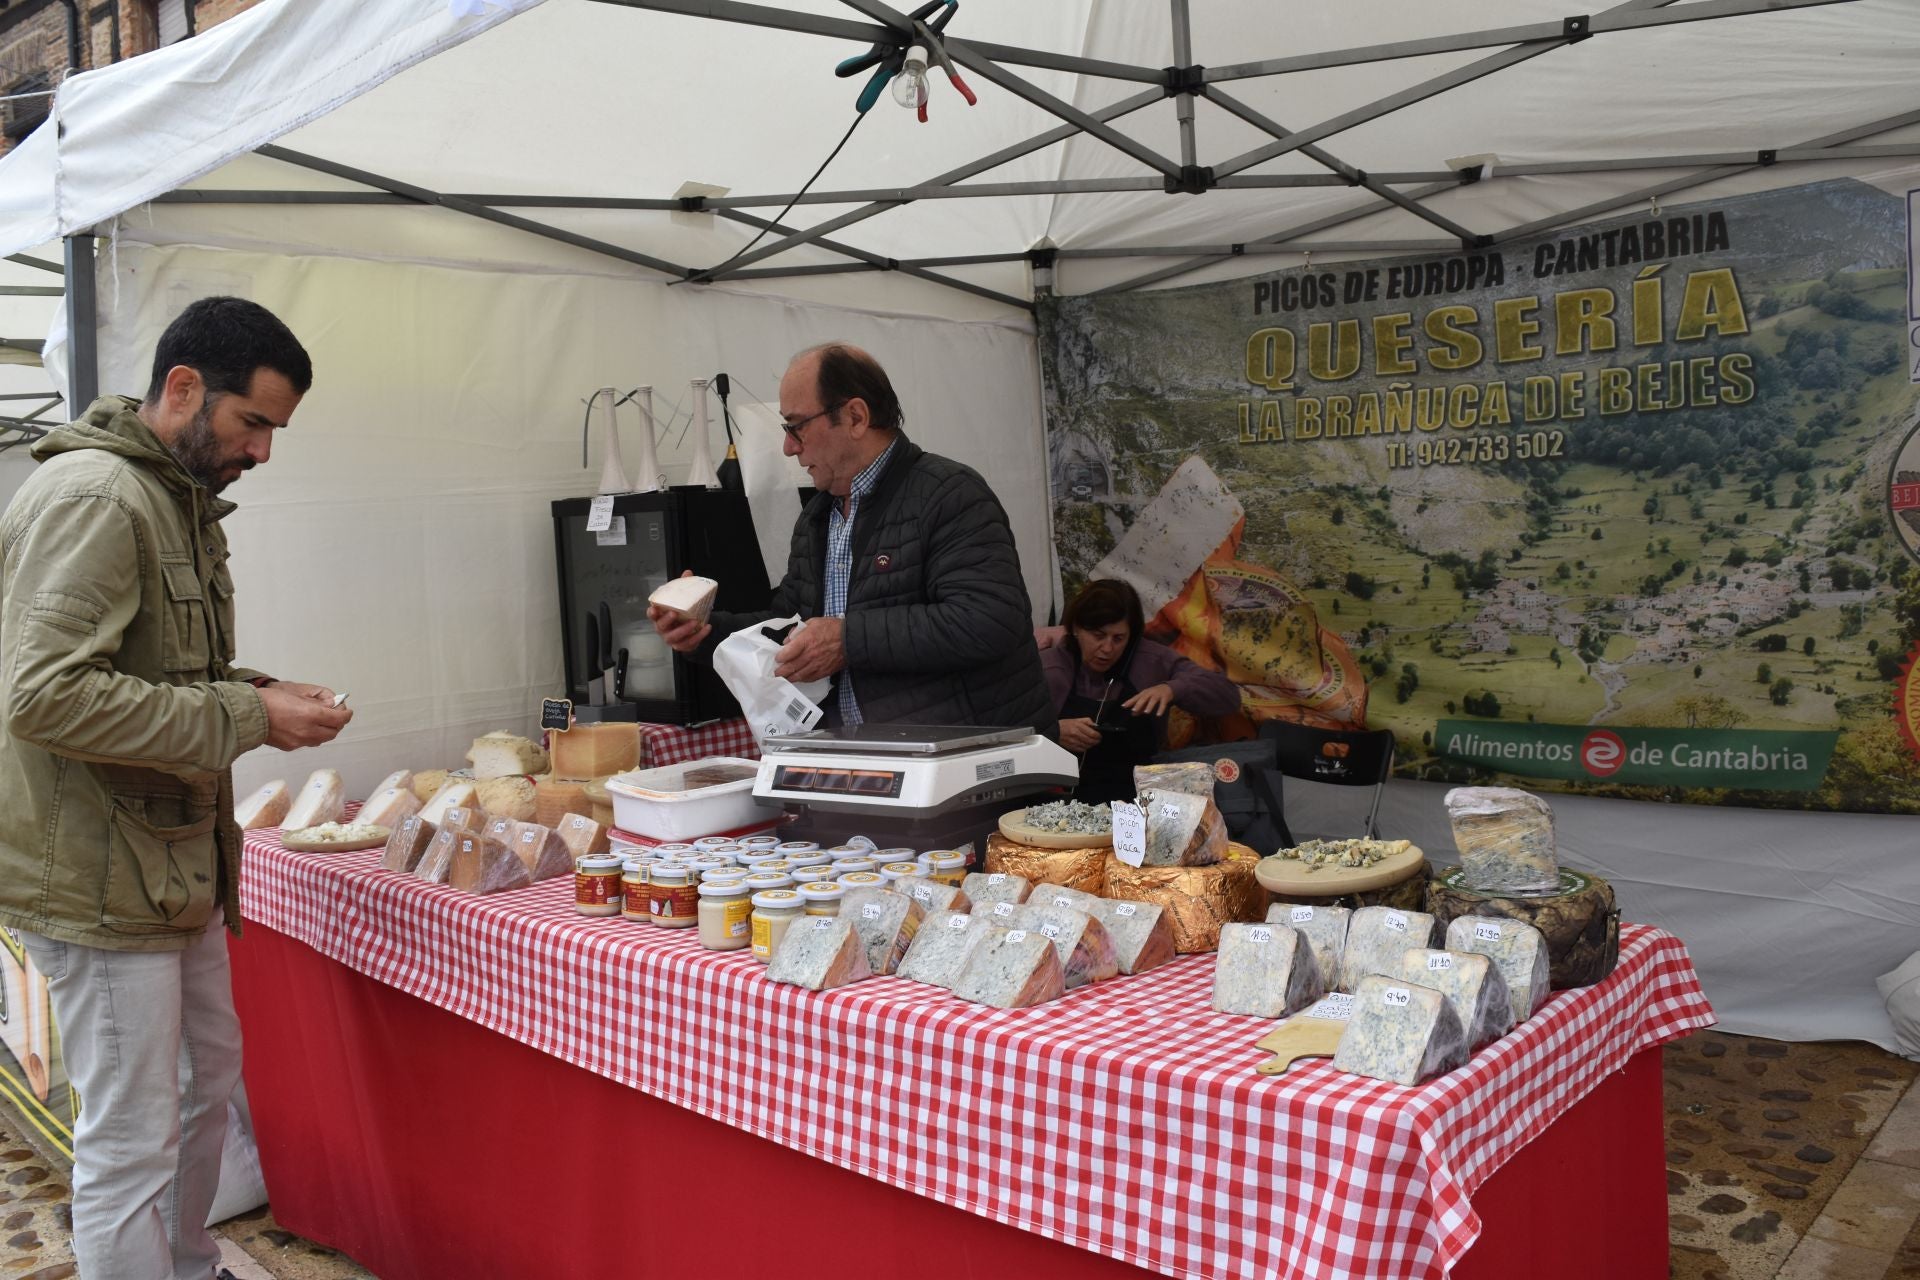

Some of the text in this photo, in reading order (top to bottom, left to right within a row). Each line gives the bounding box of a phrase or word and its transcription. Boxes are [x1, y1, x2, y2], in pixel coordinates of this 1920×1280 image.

[1253, 210, 1730, 315] PICOS DE EUROPA CANTABRIA
[1244, 262, 1749, 391] QUESERÍA
[1238, 353, 1755, 443] LA BRAÑUCA DE BEJES
[1418, 438, 1462, 467] 942
[1467, 435, 1510, 463] 733
[1516, 430, 1564, 460] 502
[1447, 733, 1809, 771] Alimentos de Cantabria
